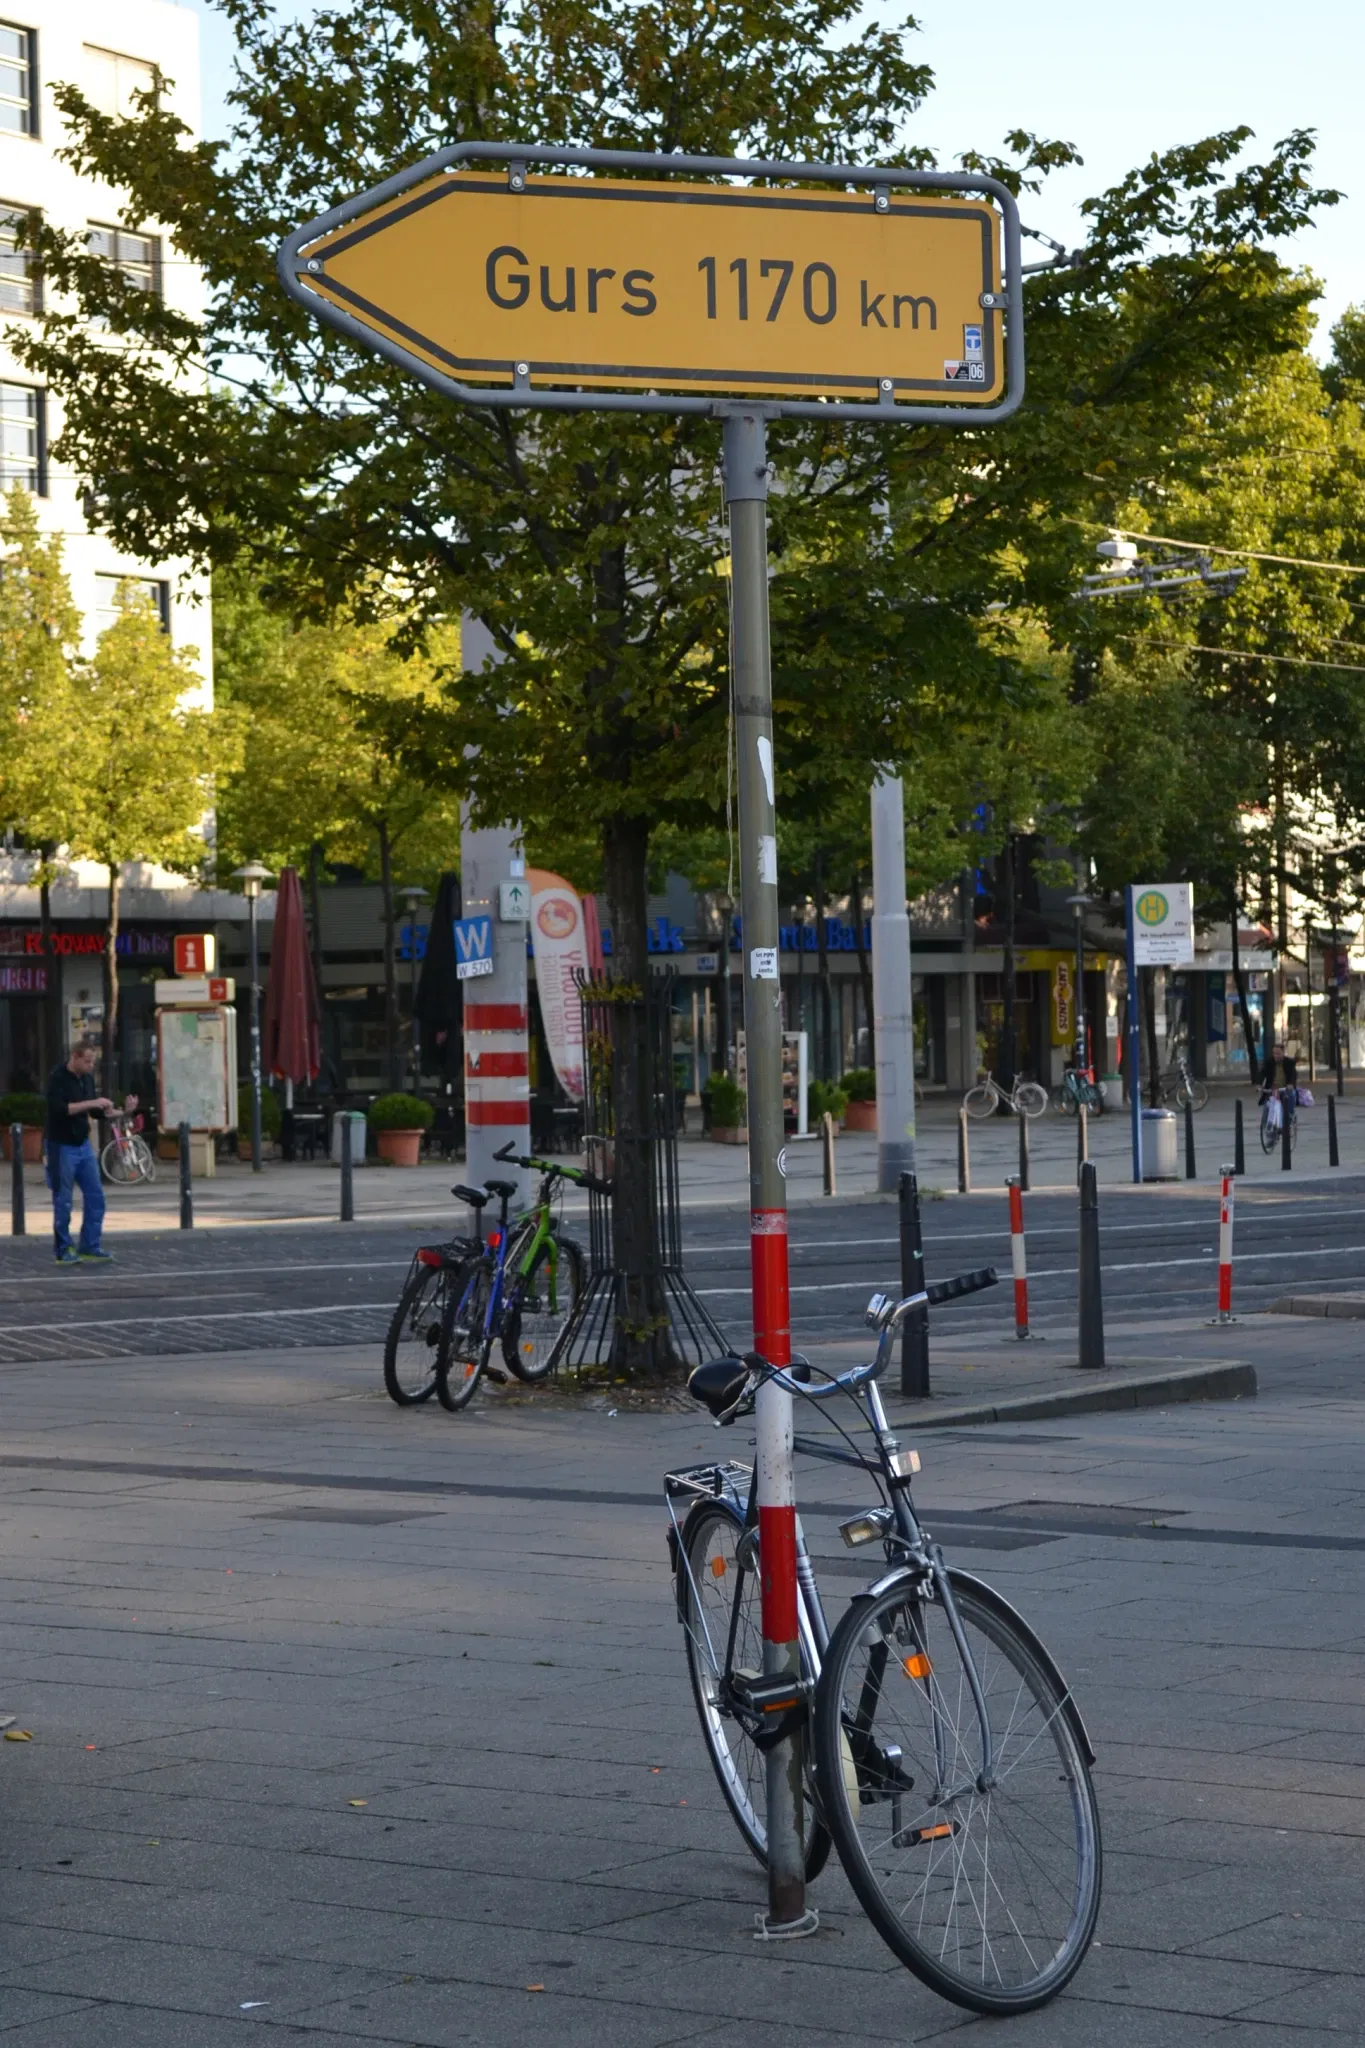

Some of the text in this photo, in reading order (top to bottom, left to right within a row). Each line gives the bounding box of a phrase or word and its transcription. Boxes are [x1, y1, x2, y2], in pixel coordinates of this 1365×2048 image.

[485, 245, 937, 331] Gurs 1170 km
[970, 364, 983, 379] 06
[455, 921, 489, 960] W
[471, 960, 491, 975] 570
